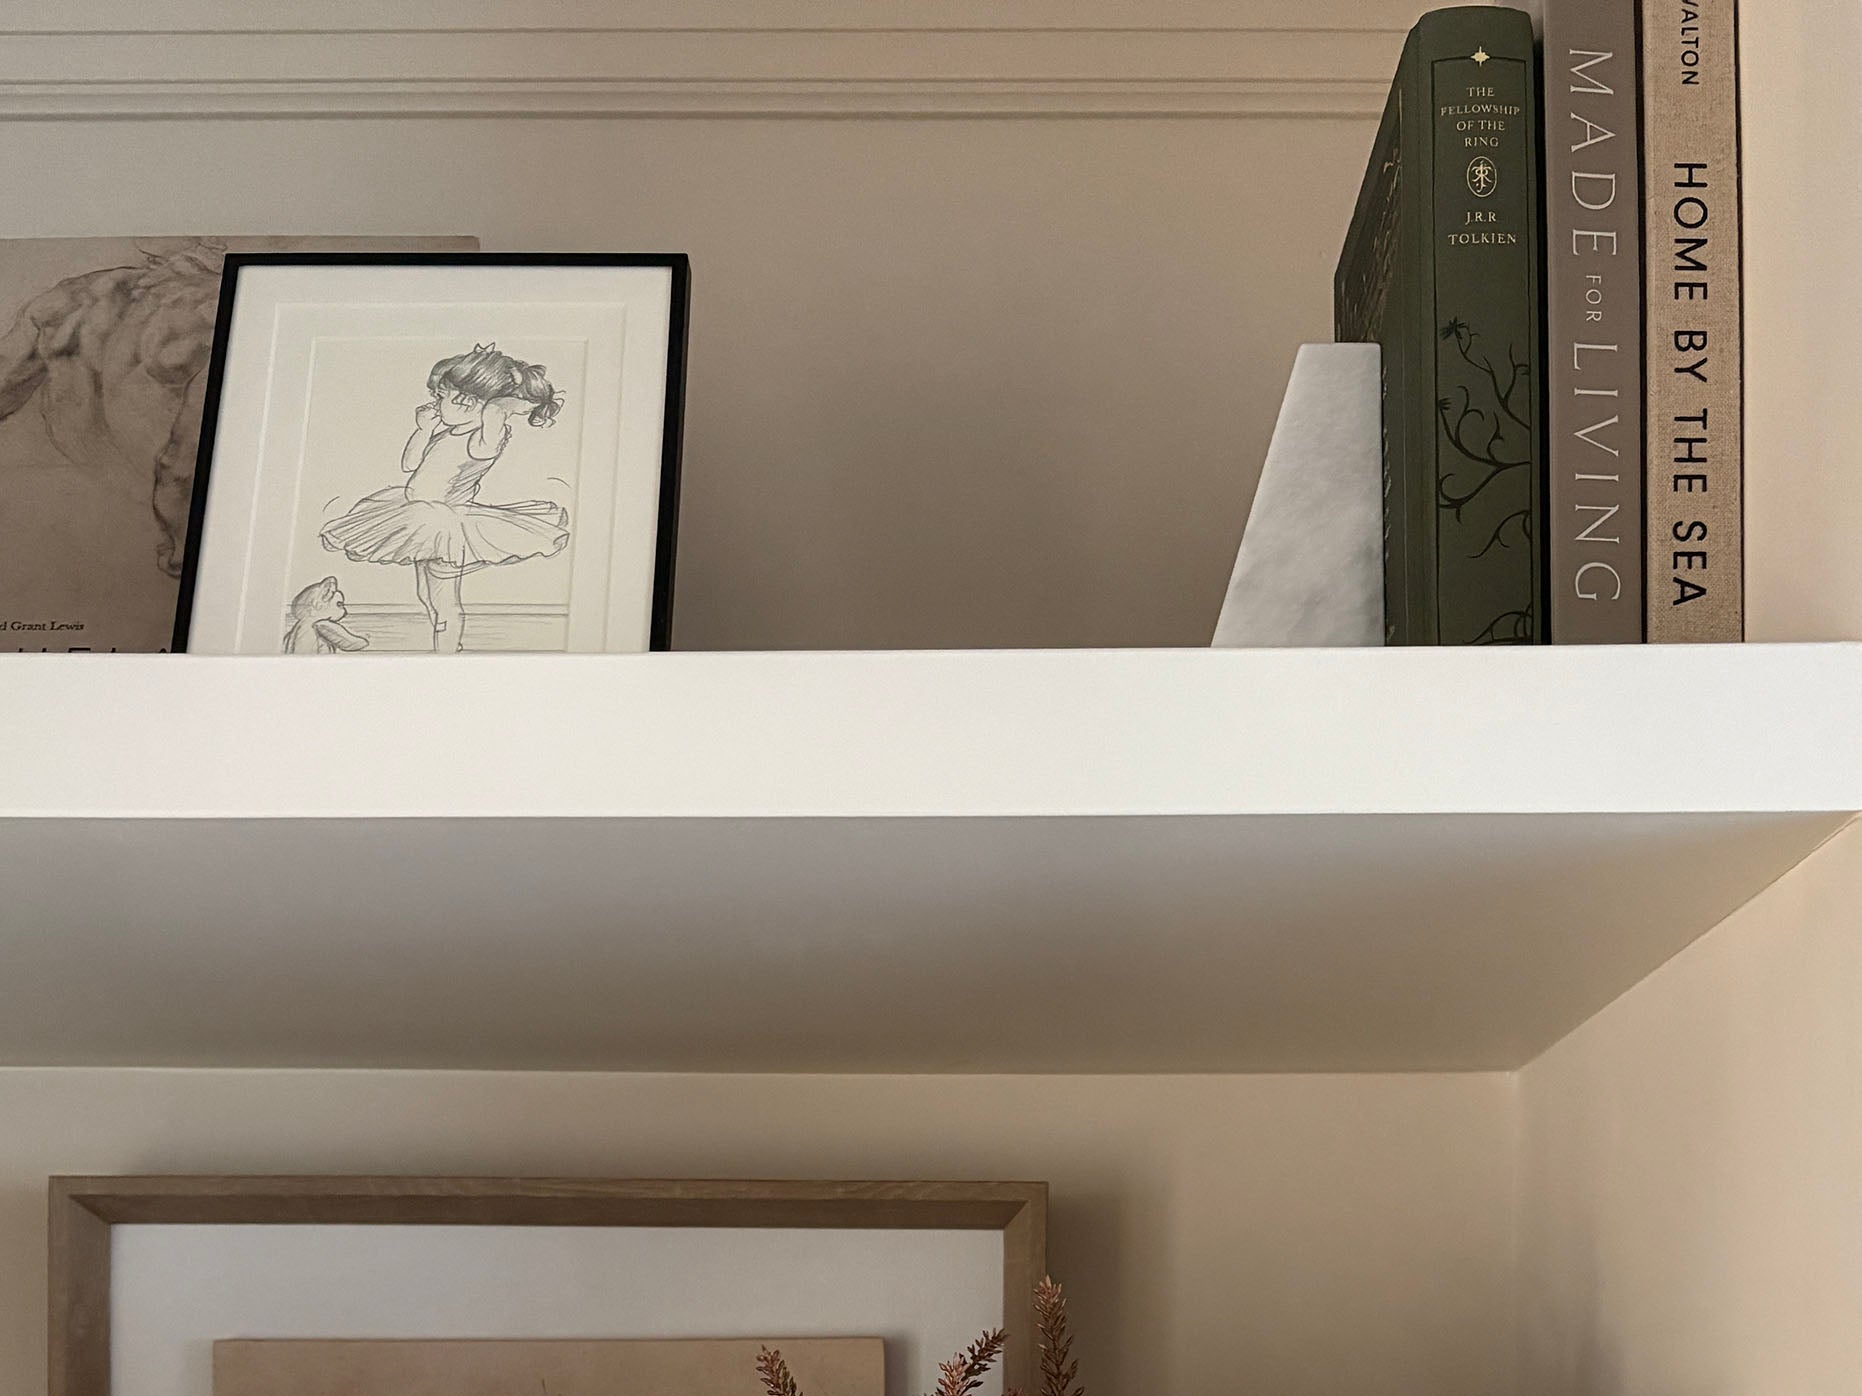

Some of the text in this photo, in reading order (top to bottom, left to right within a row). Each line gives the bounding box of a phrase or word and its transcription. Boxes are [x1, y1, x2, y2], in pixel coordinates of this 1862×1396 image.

[1466, 87, 1495, 97] THE
[1440, 104, 1520, 116] FELLOWSHIP
[1456, 120, 1506, 131] OF THE
[1464, 137, 1499, 147] RING
[1448, 233, 1517, 245] TOLKIEN
[1569, 48, 1621, 600] MADE FOR LIVING
[1672, 163, 1708, 606] HOME BY THE SEA
[11, 621, 46, 631] Grant
[50, 621, 85, 631] Lewis
